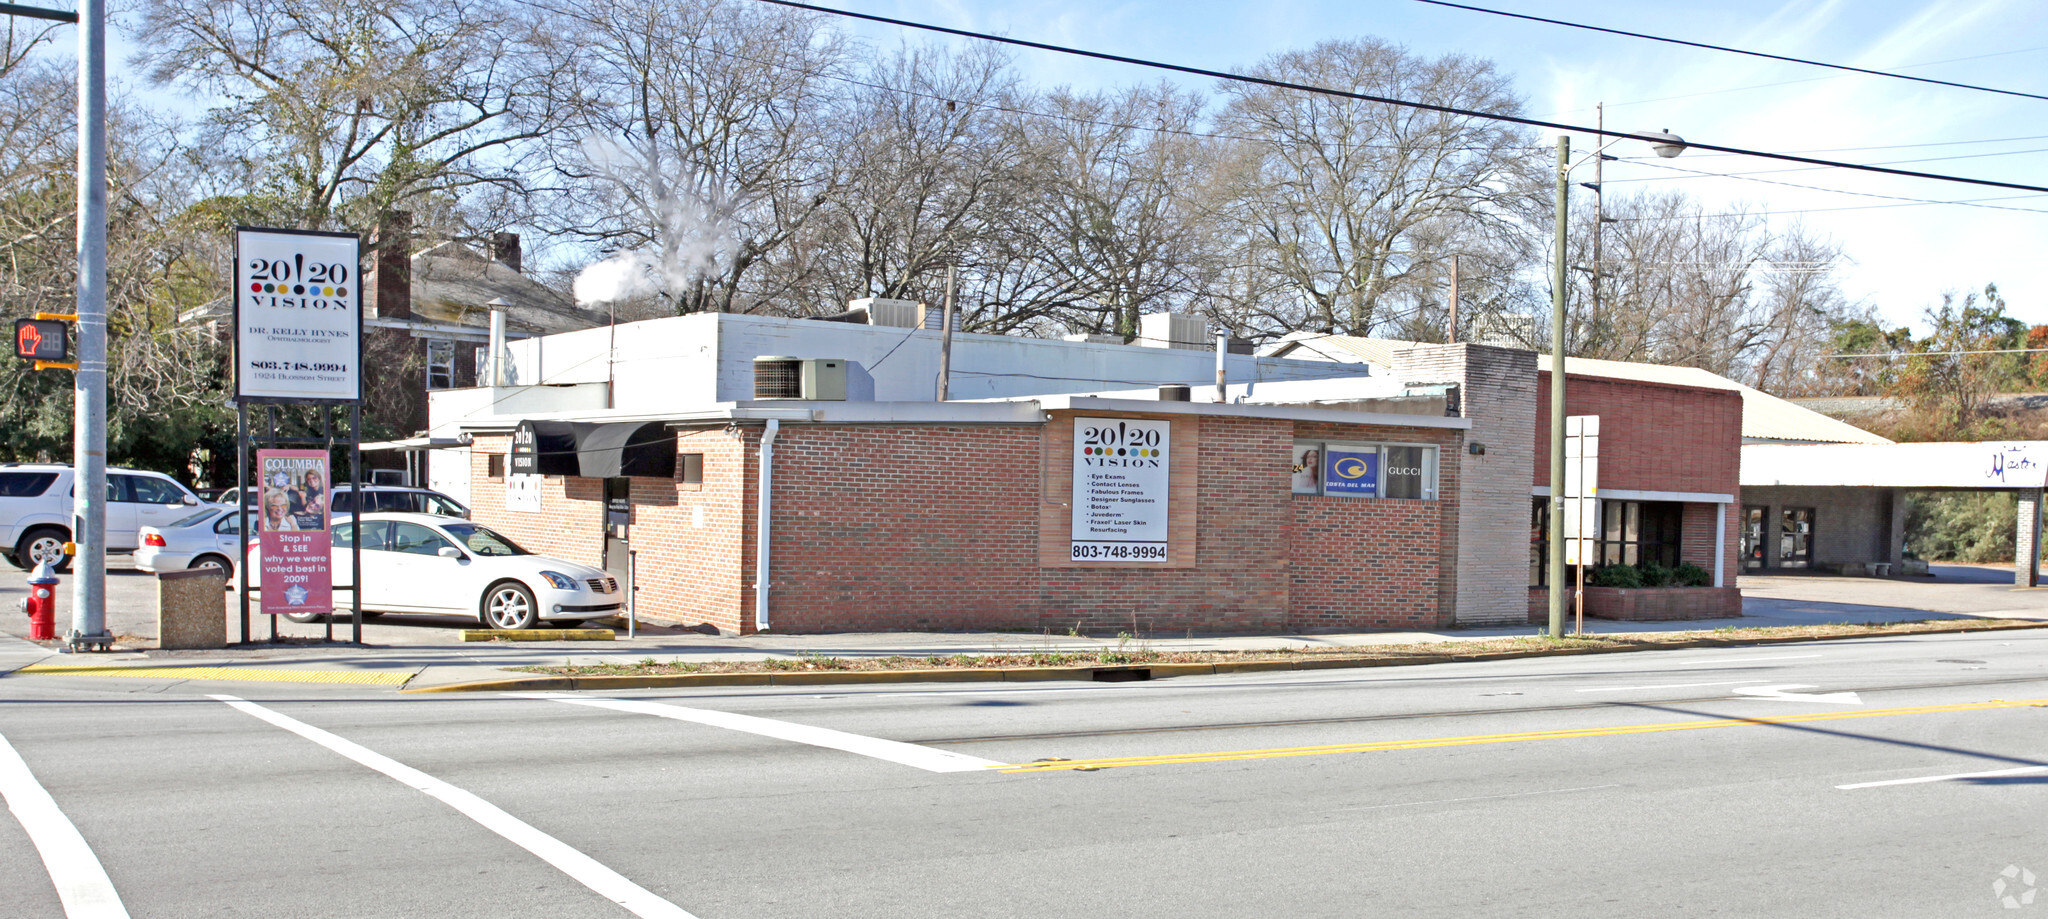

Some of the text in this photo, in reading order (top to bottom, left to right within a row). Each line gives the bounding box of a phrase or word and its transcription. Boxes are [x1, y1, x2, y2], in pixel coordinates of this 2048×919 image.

[251, 296, 347, 310] VISION
[251, 361, 347, 372] 803.748.9994
[266, 459, 323, 469] COLUMBIA
[515, 458, 531, 467] VISION
[1084, 458, 1159, 468] VISION
[1388, 467, 1420, 476] GUCCI
[280, 534, 300, 543] Stop
[1073, 545, 1165, 558] 803-748-9994
[264, 555, 284, 564] why
